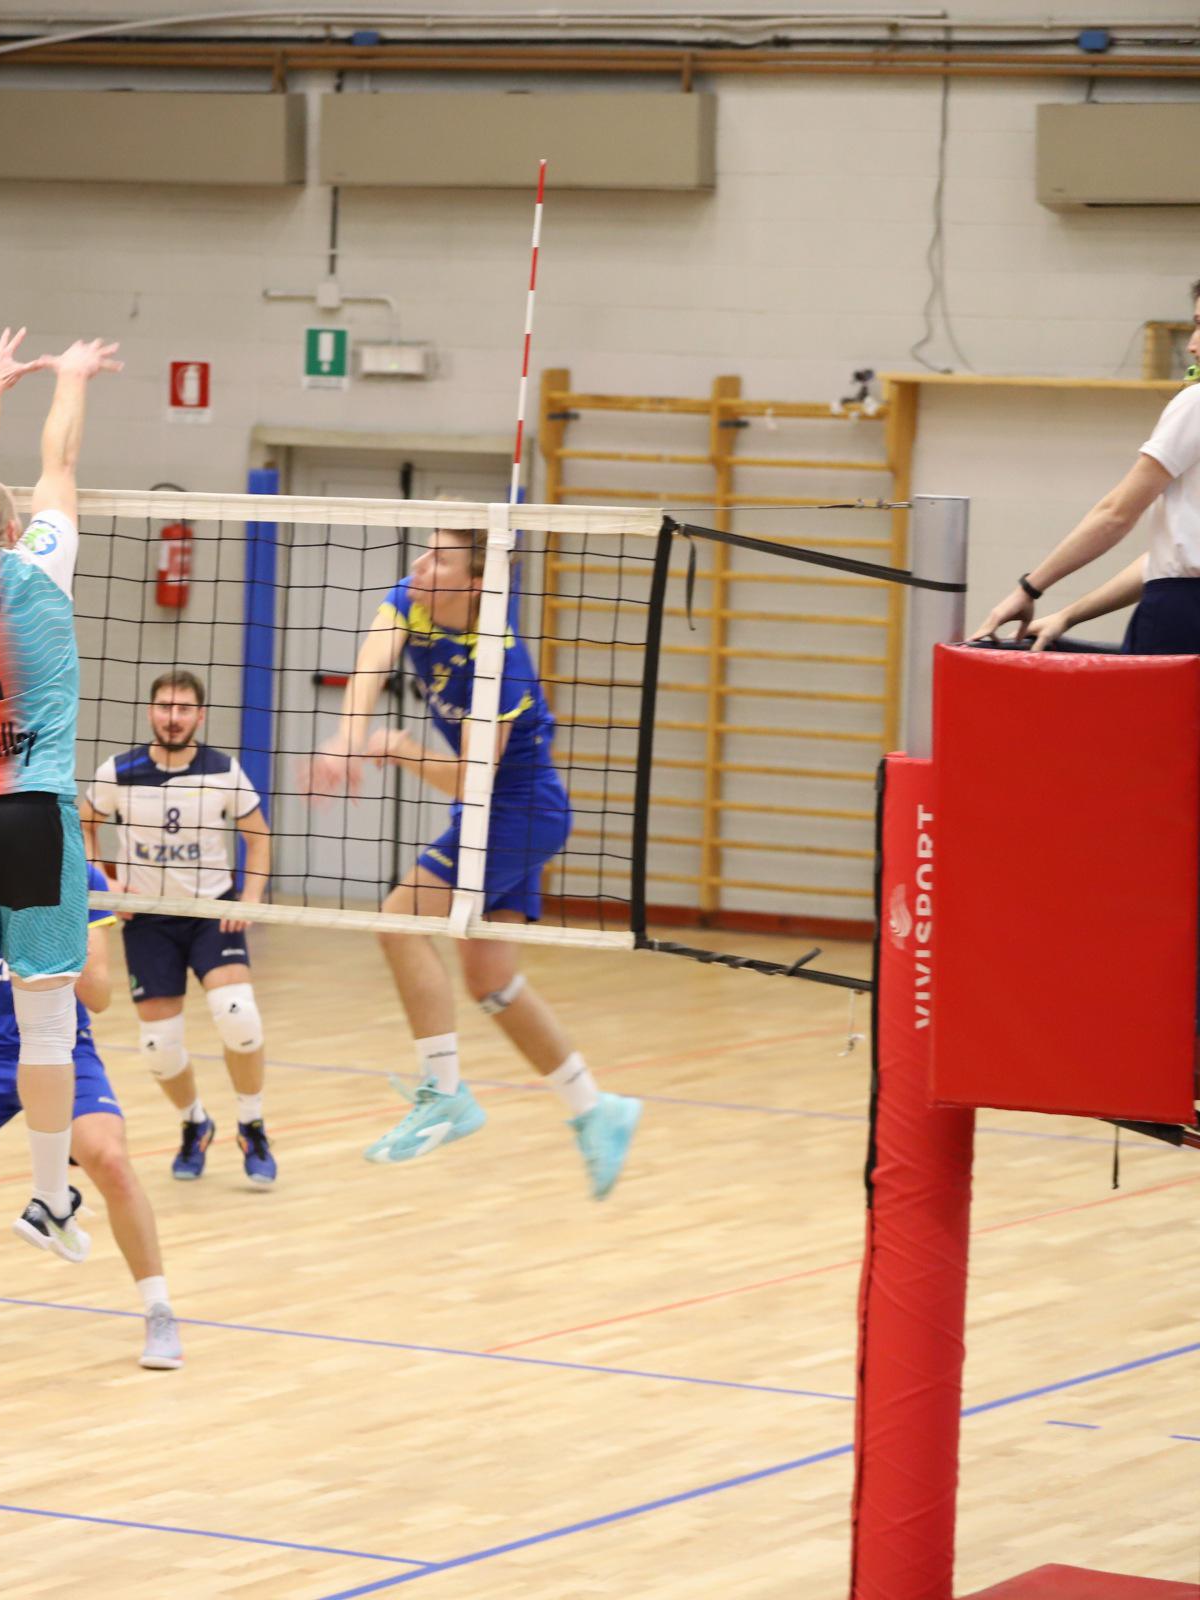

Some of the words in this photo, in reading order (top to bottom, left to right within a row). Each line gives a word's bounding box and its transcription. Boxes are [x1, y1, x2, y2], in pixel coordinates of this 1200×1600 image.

[165, 807, 181, 834] 8
[153, 843, 202, 863] ZKB
[914, 804, 934, 1030] VIVISPORT
